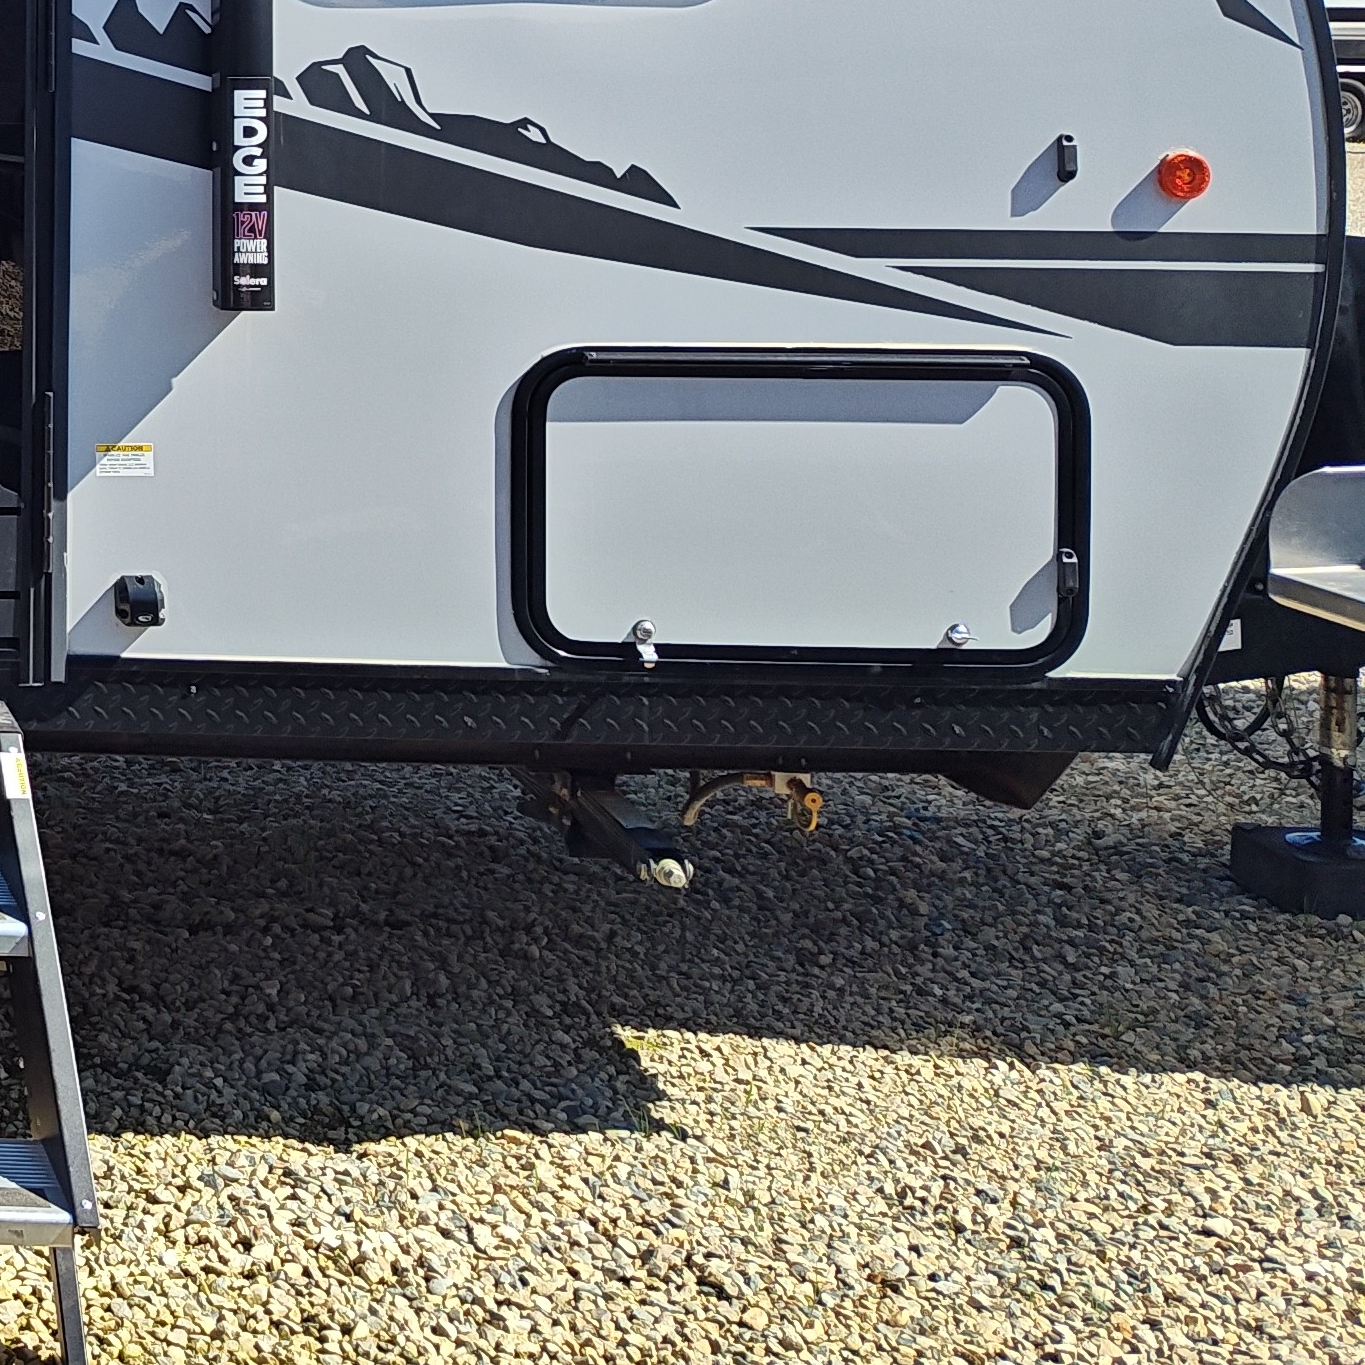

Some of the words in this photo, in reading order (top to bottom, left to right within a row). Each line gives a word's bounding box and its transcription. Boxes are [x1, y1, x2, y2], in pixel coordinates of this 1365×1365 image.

[232, 89, 268, 203] EDGE
[233, 211, 268, 239] 12V
[233, 239, 268, 253] POWER
[233, 252, 269, 265] AWNING
